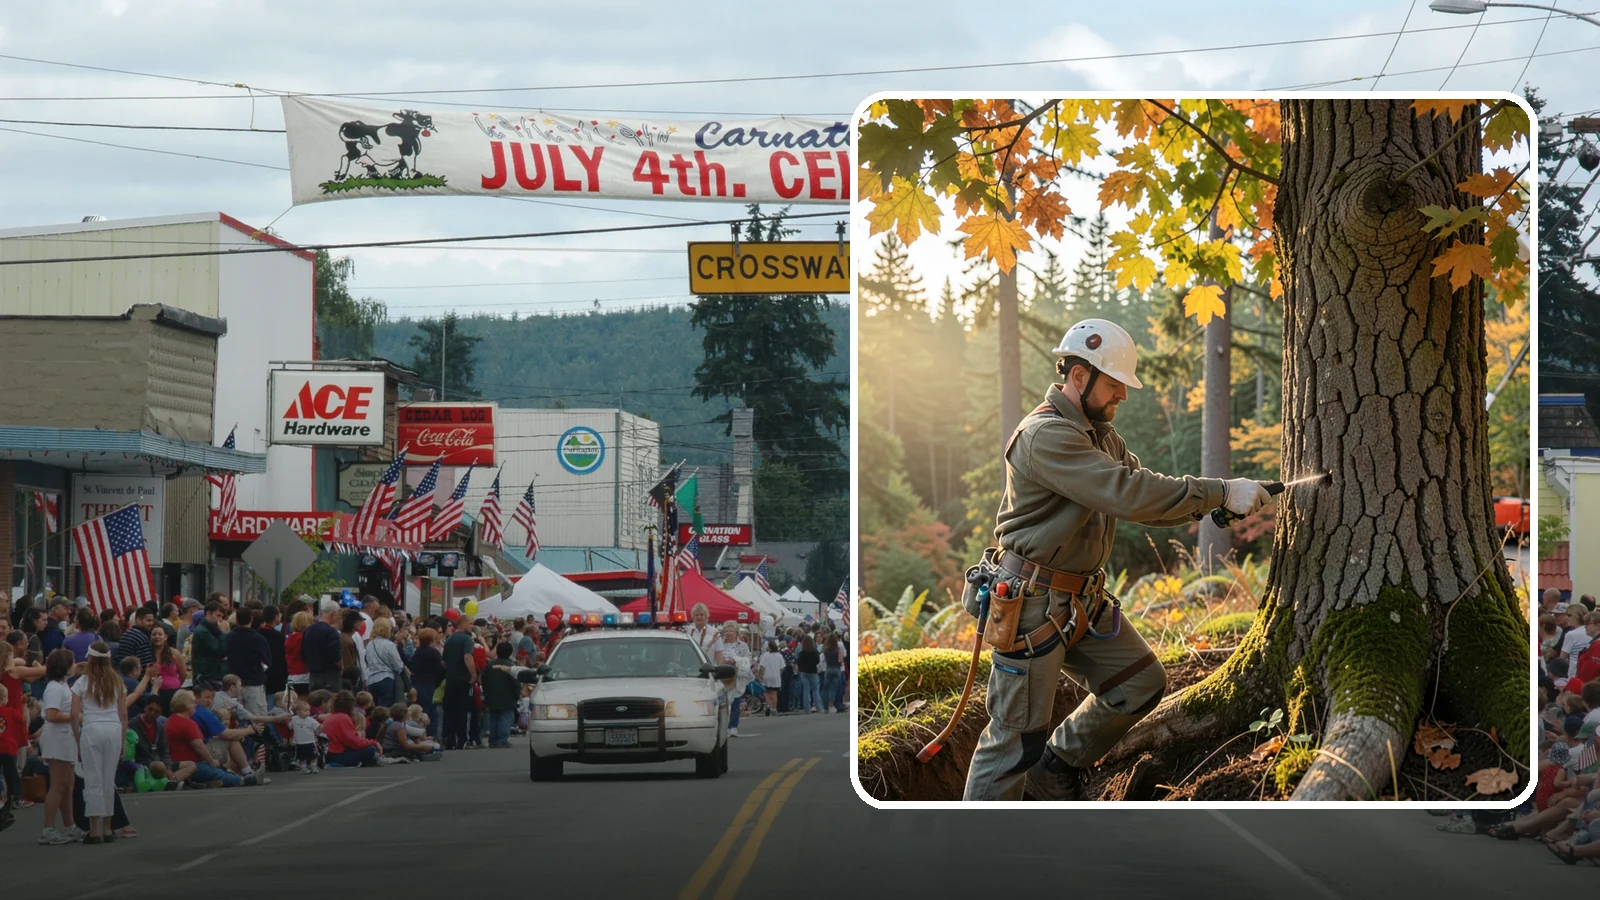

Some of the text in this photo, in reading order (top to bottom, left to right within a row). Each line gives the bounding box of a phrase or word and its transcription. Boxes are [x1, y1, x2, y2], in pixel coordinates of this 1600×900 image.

[481, 141, 605, 192] JULY
[632, 150, 746, 197] 4th.
[697, 254, 849, 279] CROSSWA
[283, 380, 373, 420] ACE
[406, 410, 485, 421] CEDAR LOG
[283, 421, 371, 437] Hardware
[83, 485, 155, 495] St. Vincent de Paul
[213, 515, 331, 536] HARDARE
[688, 526, 741, 535] CRNATION
[699, 535, 730, 543] GLASS
